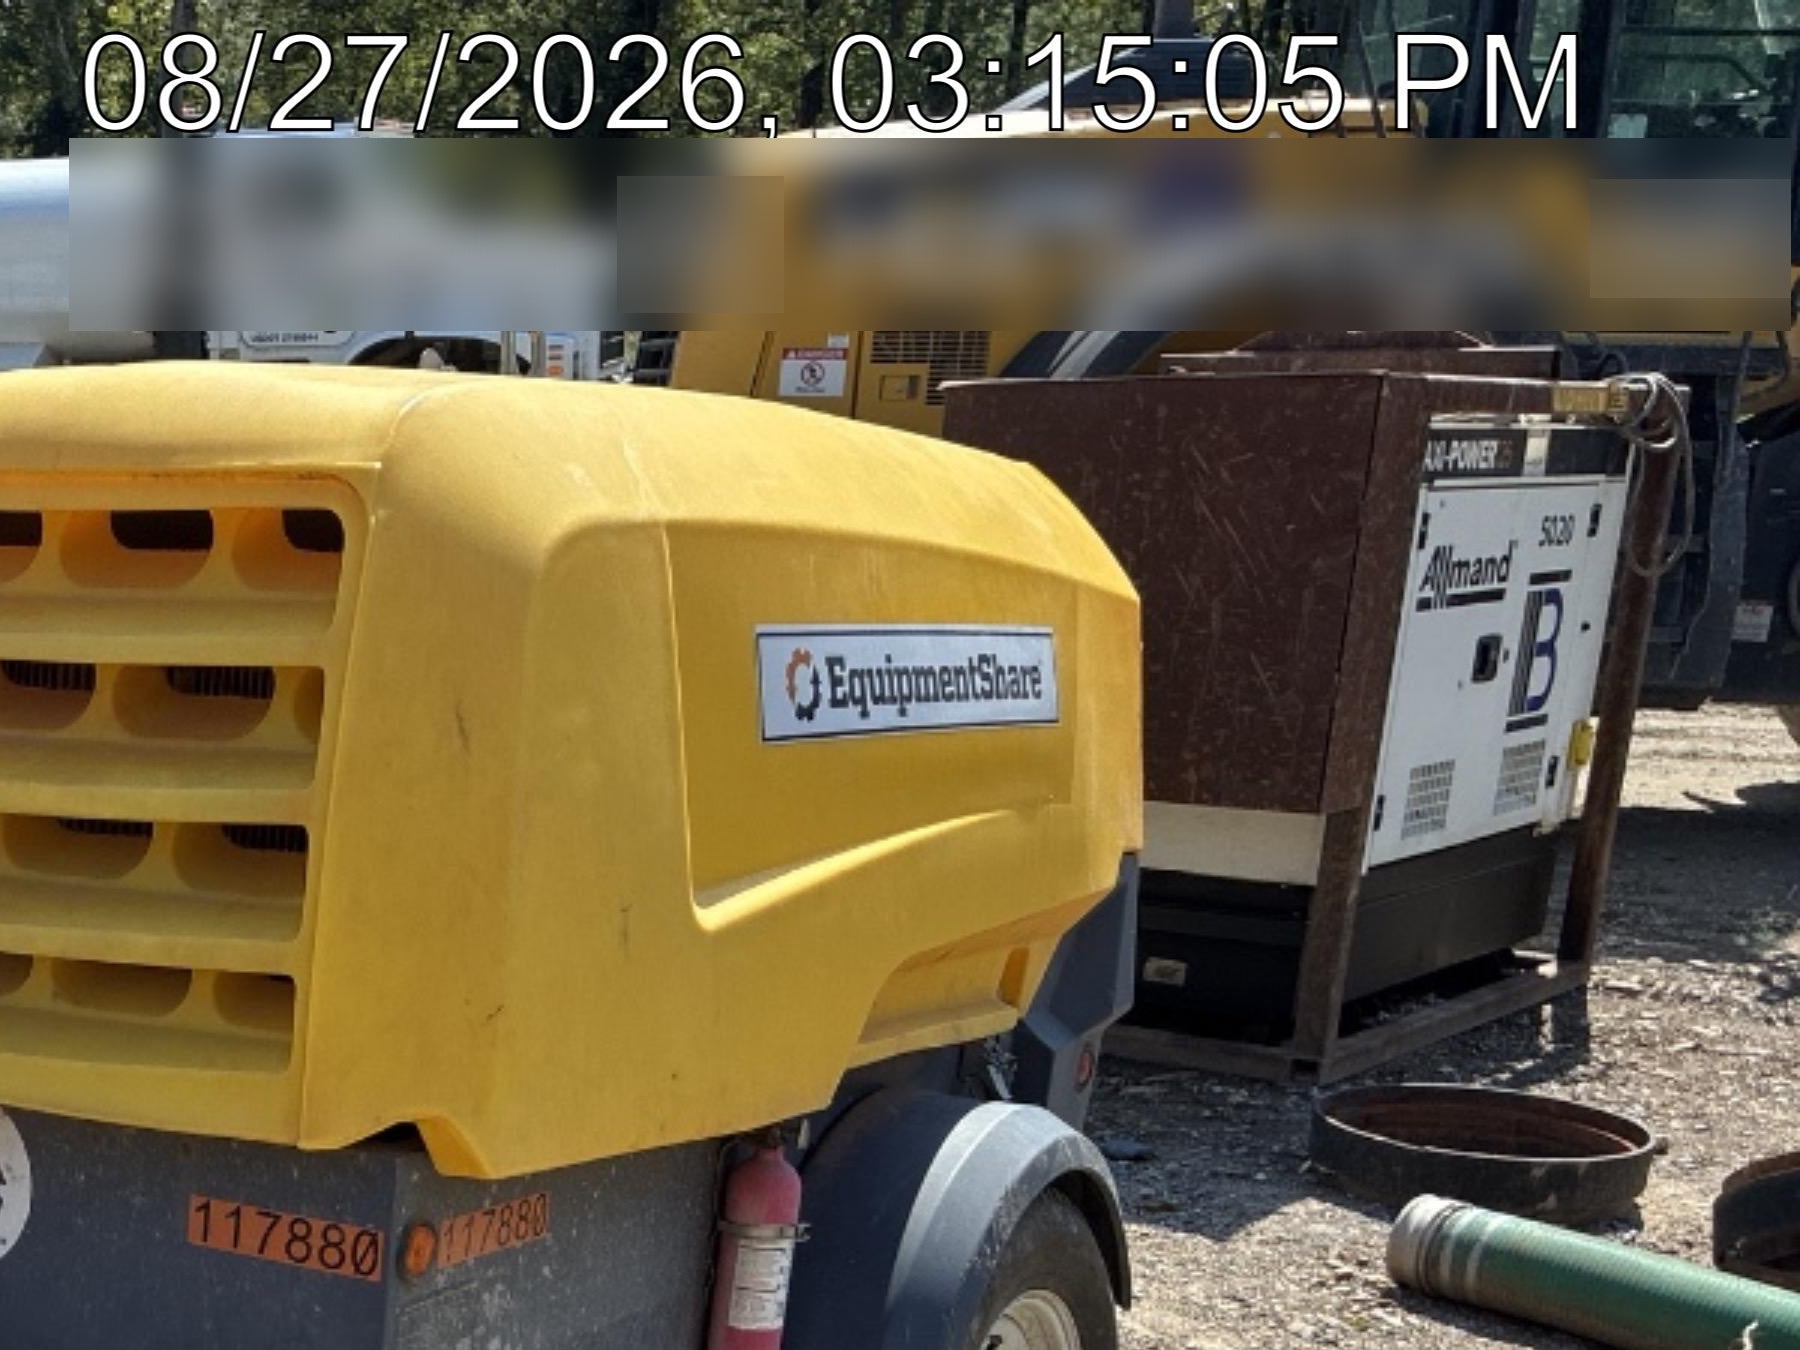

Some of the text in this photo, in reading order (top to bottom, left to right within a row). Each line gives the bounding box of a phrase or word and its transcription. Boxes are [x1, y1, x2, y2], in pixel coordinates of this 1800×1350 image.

[1421, 439, 1498, 472] AXI-POWER
[1419, 540, 1512, 594] Allmand
[824, 652, 1043, 719] EquipmentShare
[194, 1199, 380, 1276] 117880
[441, 1192, 548, 1262] 117880
